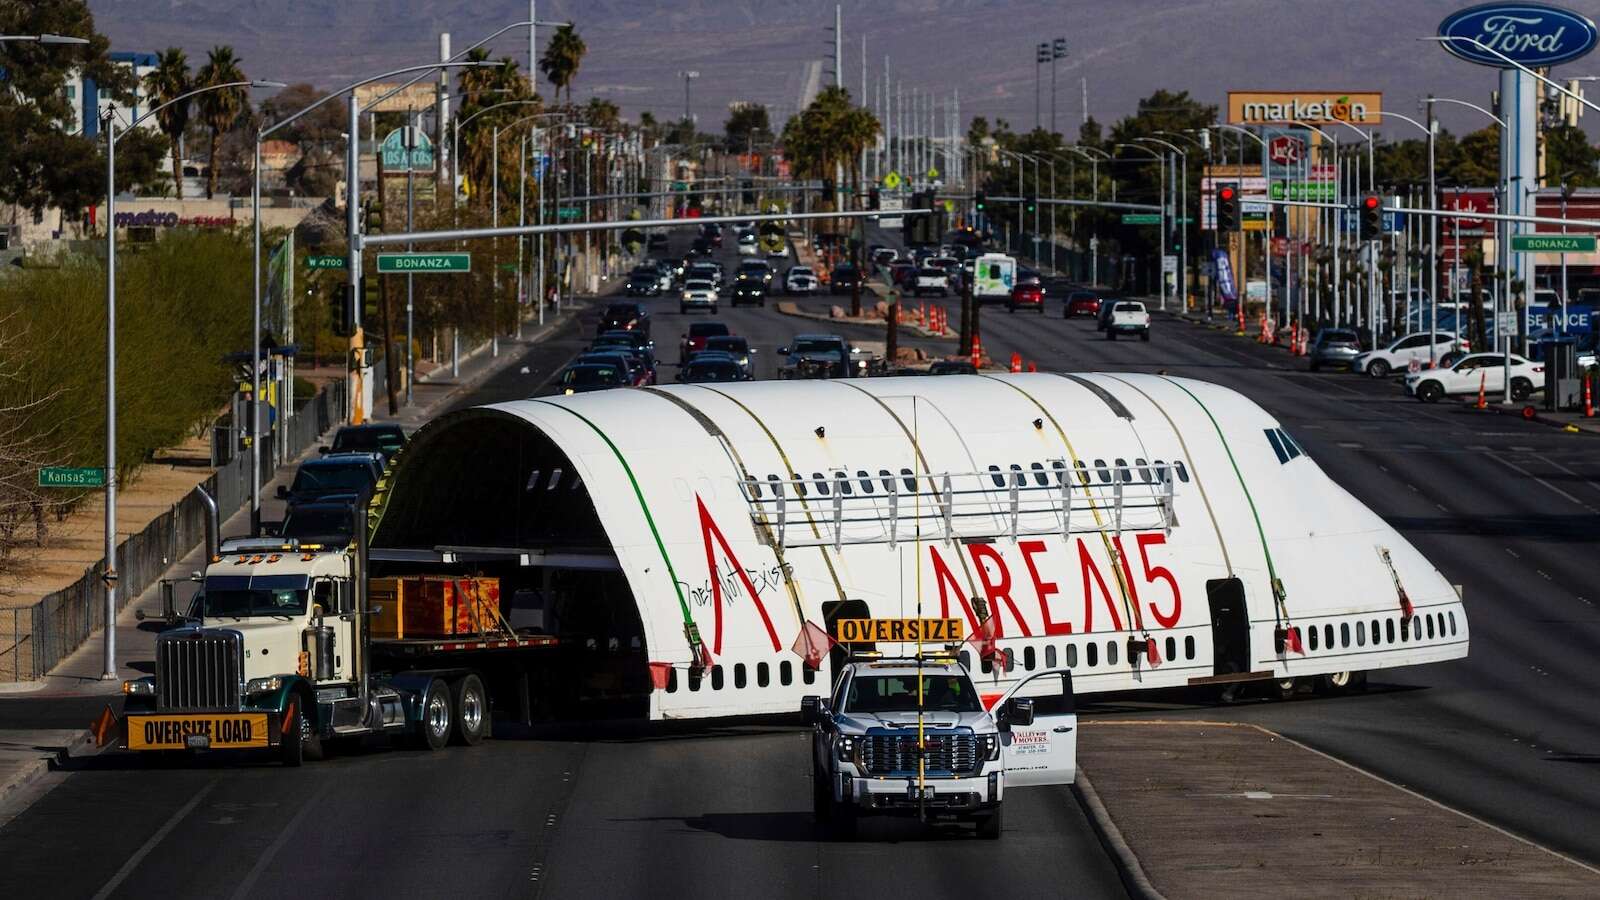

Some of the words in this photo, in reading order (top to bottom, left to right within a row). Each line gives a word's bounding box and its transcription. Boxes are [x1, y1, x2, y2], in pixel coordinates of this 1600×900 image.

[1474, 15, 1566, 53] Ford
[1243, 96, 1367, 121] marketon
[383, 151, 400, 164] LOS
[401, 151, 432, 164] ACOS
[114, 209, 178, 228] metro
[1527, 239, 1579, 249] BONANZA
[309, 257, 317, 266] W
[319, 257, 343, 266] 4700
[395, 256, 452, 268] BONANZA
[48, 471, 85, 483] Kansas
[842, 619, 961, 641] OVERSIZE
[144, 719, 212, 745] OVERSIZE
[215, 719, 252, 744] LOAD
